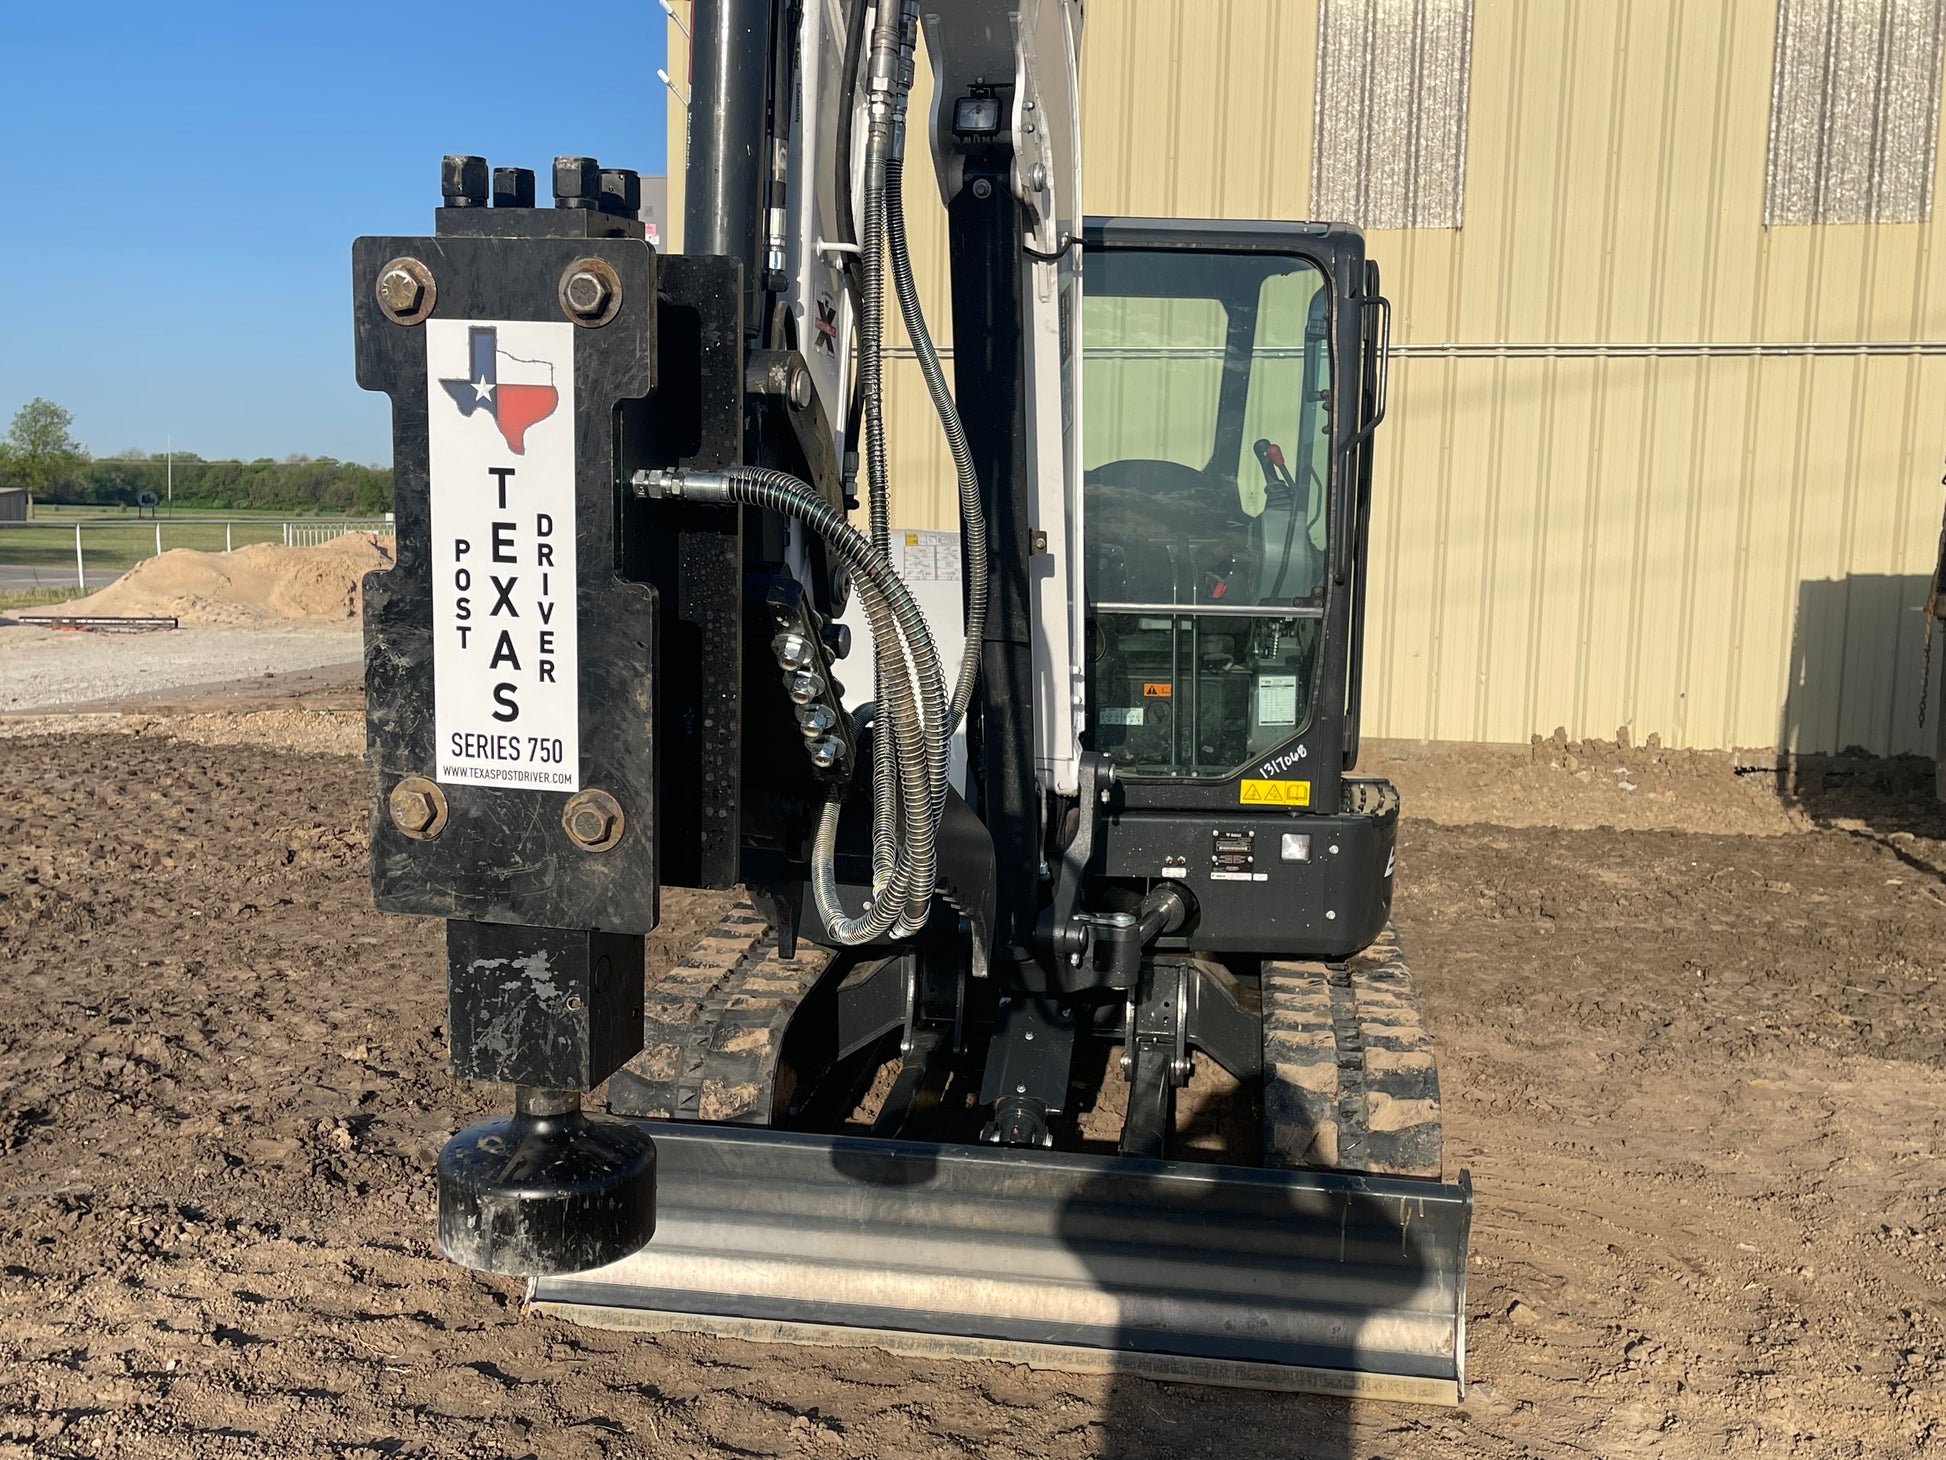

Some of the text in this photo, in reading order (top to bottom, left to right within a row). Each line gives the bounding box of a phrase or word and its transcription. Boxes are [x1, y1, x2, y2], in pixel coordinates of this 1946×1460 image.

[455, 538, 471, 649] POST
[488, 467, 522, 723] TEXAS
[536, 513, 556, 683] DRIVER
[443, 765, 572, 785] WWW.TEXASPOSTDRIVER.COM
[451, 732, 563, 764] SERIES 750
[1259, 743, 1307, 779] 1317068
